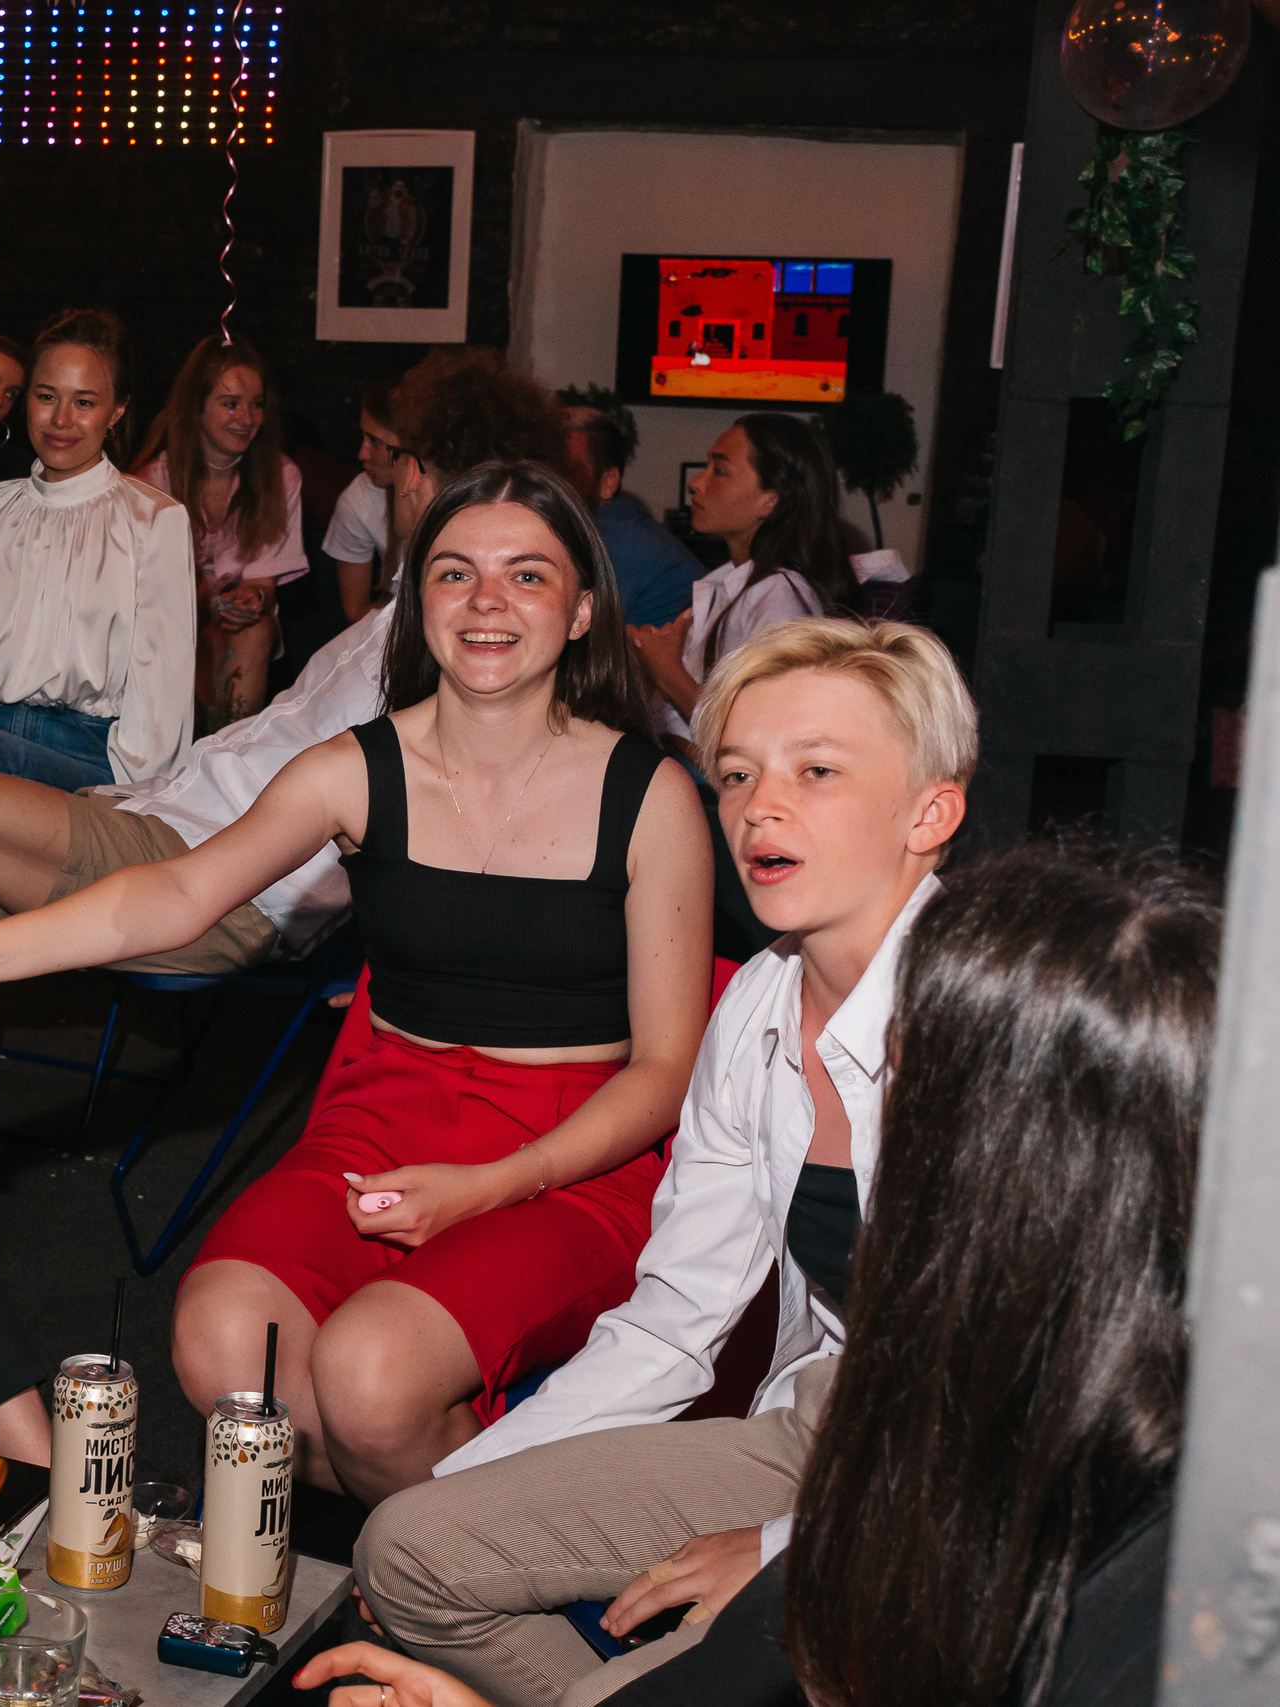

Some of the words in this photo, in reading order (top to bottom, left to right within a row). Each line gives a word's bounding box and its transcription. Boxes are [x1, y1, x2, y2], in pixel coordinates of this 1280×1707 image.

[79, 1450, 135, 1495] ЛИС
[261, 1473, 290, 1497] МИС
[98, 1494, 128, 1507] СИДР
[254, 1491, 290, 1537] ЛИ
[88, 1556, 126, 1575] ГРУША
[262, 1600, 283, 1618] ГРУ
